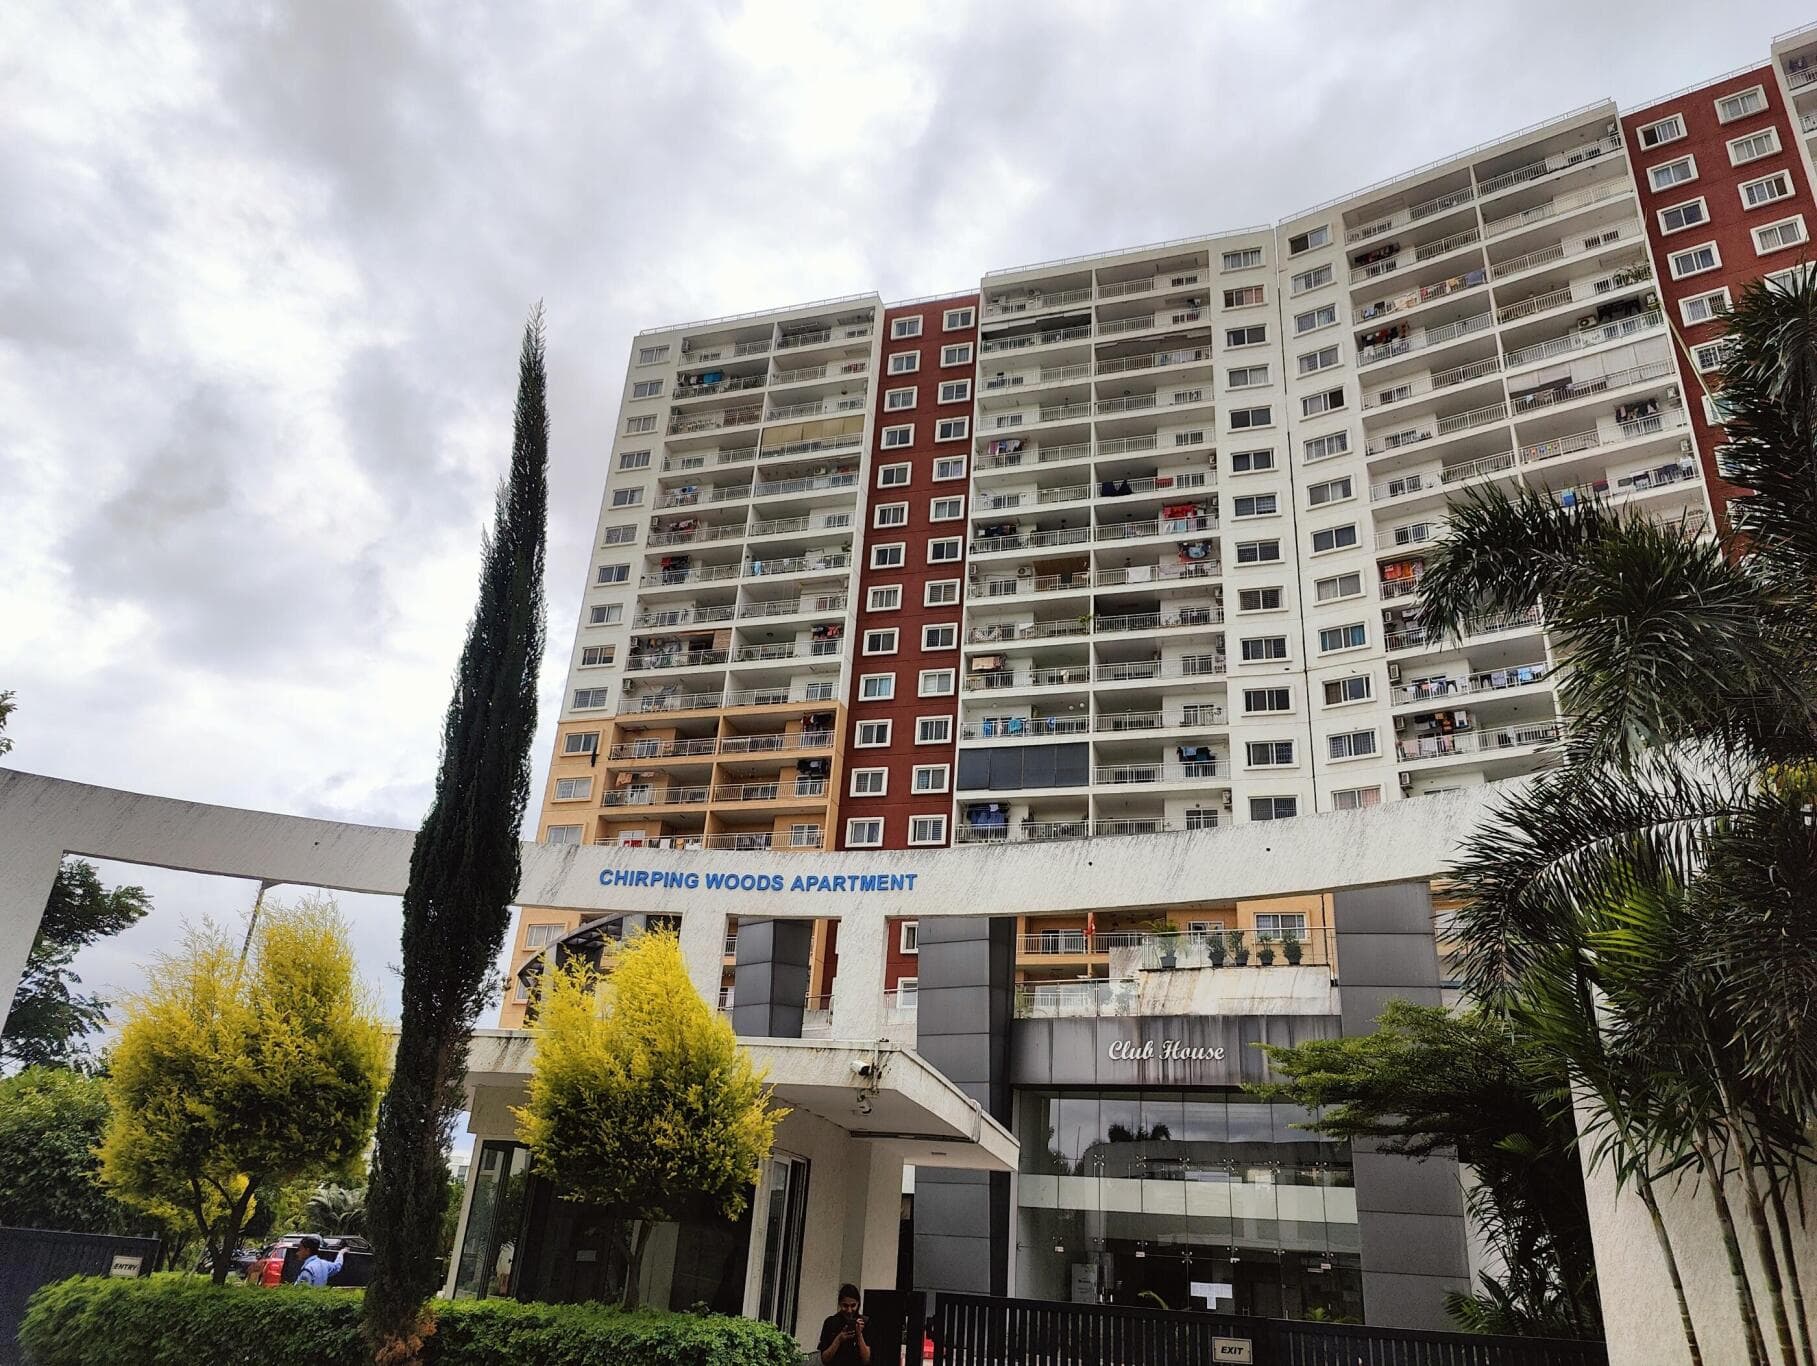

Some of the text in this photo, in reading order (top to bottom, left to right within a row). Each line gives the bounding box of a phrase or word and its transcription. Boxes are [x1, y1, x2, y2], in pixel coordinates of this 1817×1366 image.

[599, 869, 917, 892] CHIRPING WOODS APARTMENT
[1108, 1040, 1225, 1060] Club House
[1221, 1346, 1244, 1355] EXIT
